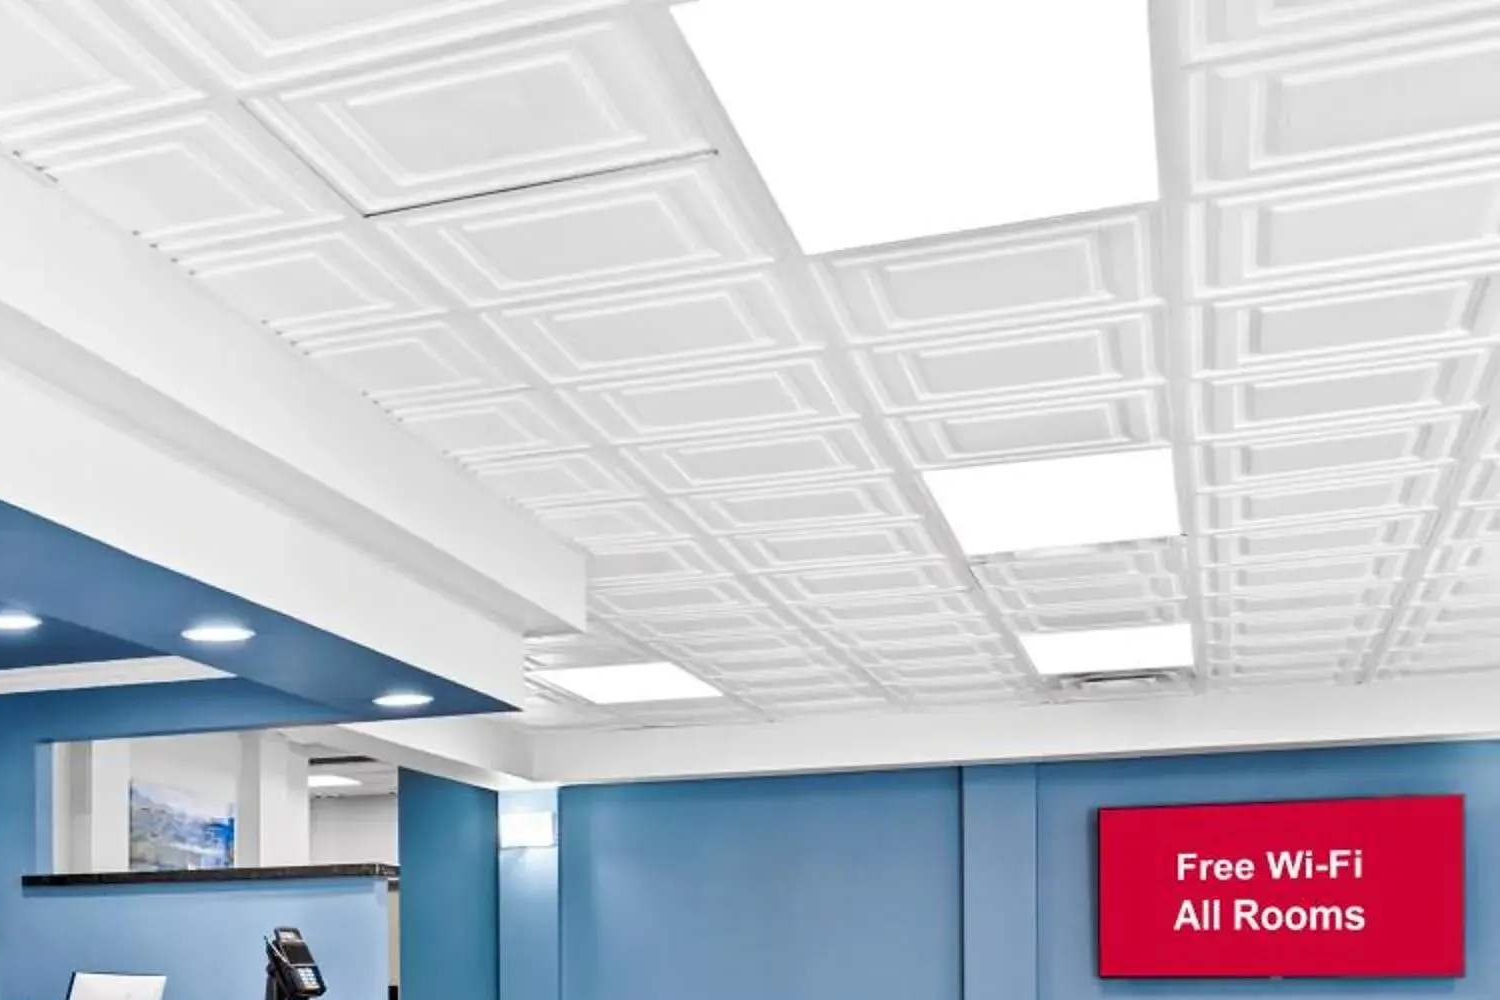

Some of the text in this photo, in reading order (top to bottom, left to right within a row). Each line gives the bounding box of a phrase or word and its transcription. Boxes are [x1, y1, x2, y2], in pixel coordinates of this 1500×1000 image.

[1176, 849, 1363, 881] Free Wi-Fi
[1173, 899, 1366, 931] All Rooms
